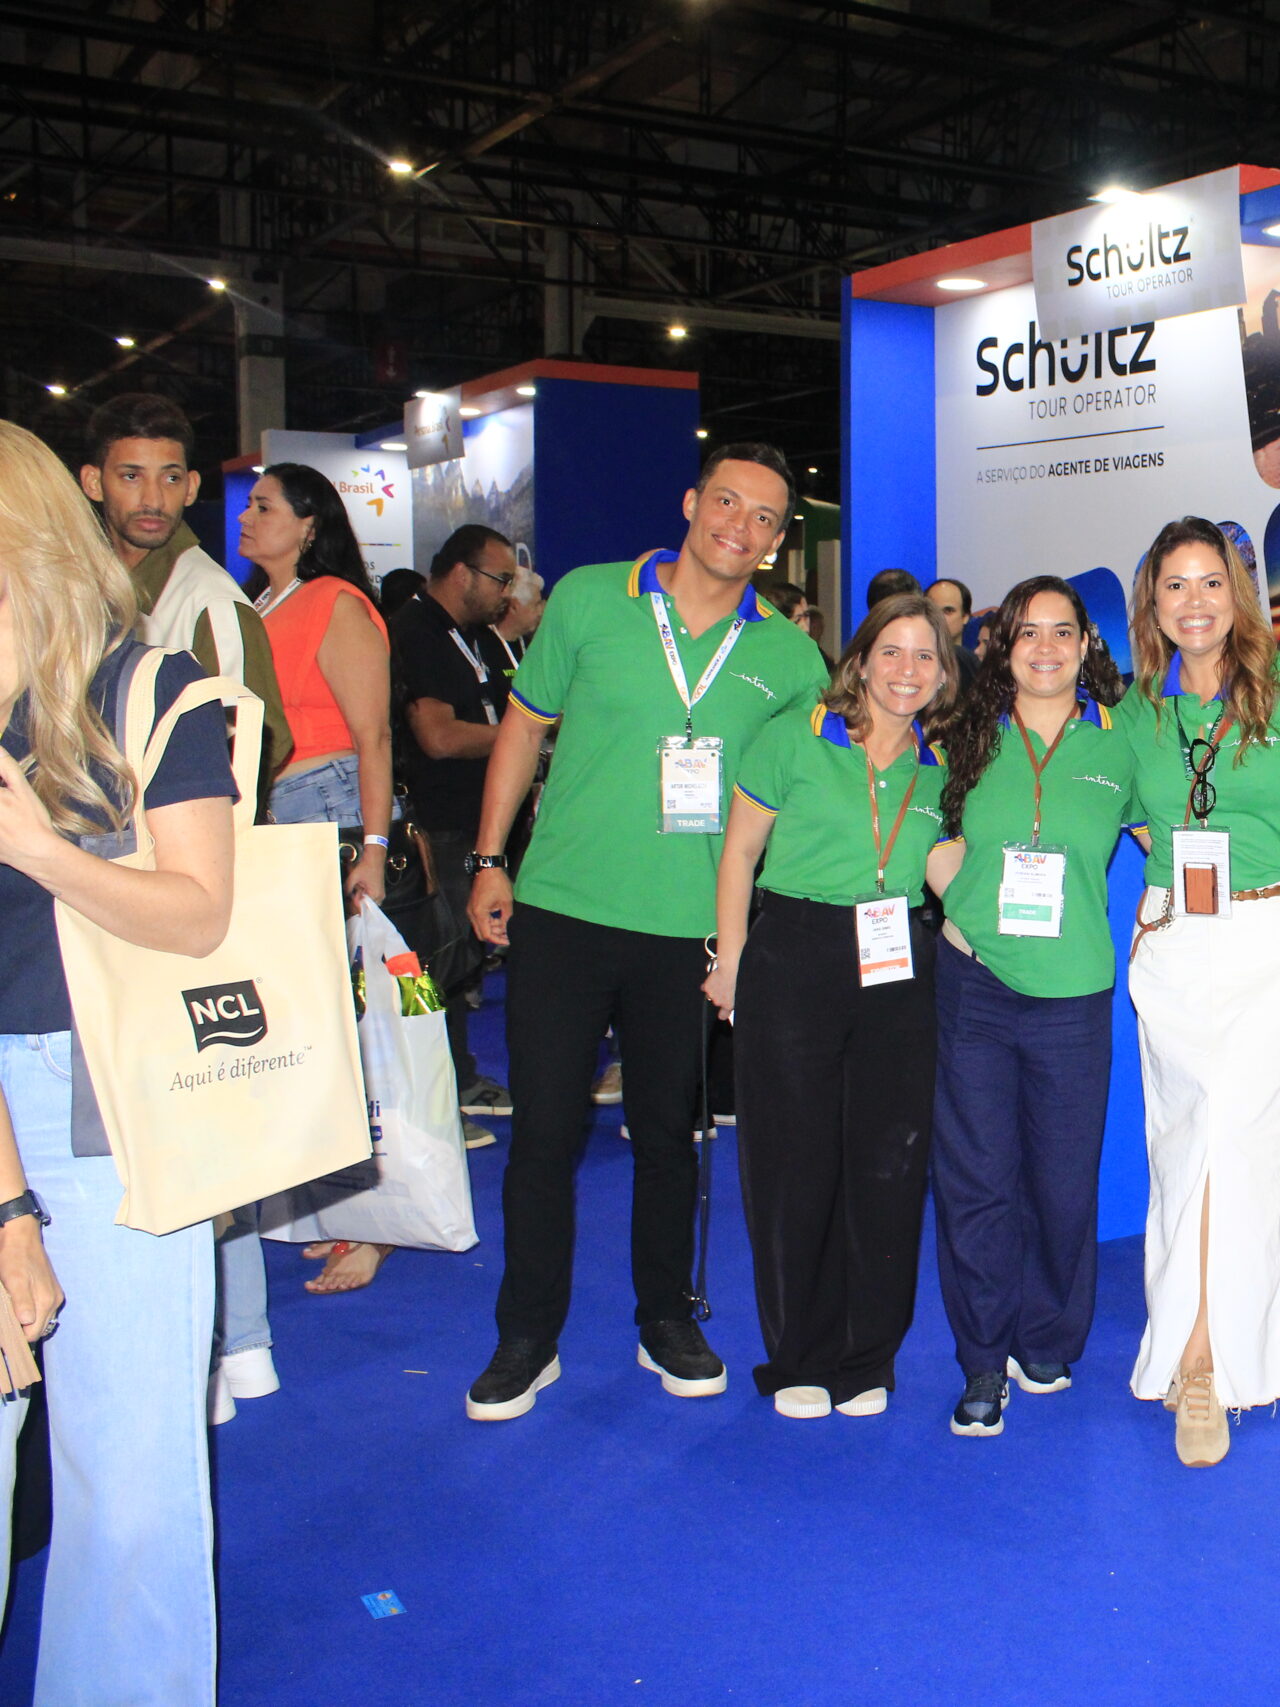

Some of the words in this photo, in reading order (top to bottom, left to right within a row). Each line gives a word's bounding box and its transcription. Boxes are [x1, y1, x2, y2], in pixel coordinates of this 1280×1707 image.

[1106, 281, 1134, 299] TOUR
[1138, 267, 1194, 292] OPERATOR
[1028, 397, 1067, 420] TOUR
[1073, 384, 1157, 414] OPERATOR
[976, 471, 984, 484] A
[985, 466, 1027, 484] SERVIÇO
[1030, 464, 1046, 480] DO
[1048, 459, 1091, 477] AGENTE
[1094, 458, 1110, 472] DE
[1113, 452, 1165, 471] VIAGENS
[339, 481, 374, 494] Brasil
[676, 819, 706, 827] TRADE
[190, 993, 260, 1025] NCL
[169, 1065, 214, 1092] Aqui
[217, 1062, 226, 1082] é
